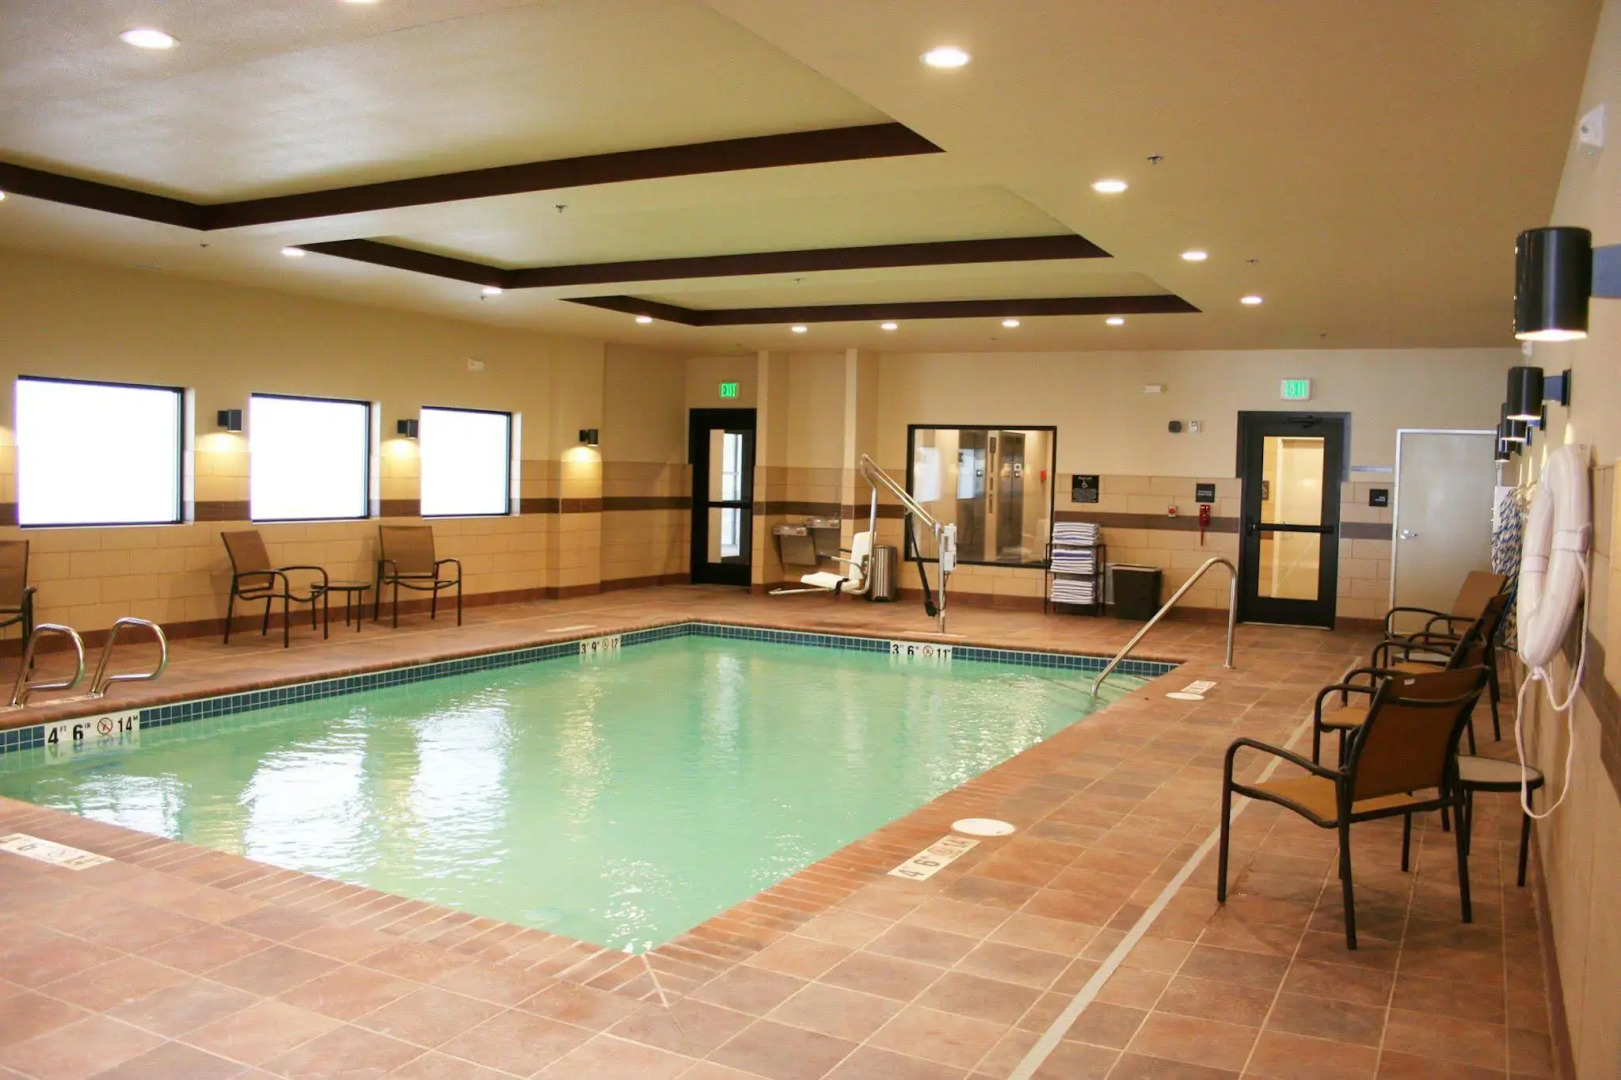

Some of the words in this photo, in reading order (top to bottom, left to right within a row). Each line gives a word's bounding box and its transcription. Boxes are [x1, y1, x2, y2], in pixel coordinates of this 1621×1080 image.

[581, 643, 587, 654] 3
[892, 644, 899, 655] 3
[907, 645, 914, 656] 6
